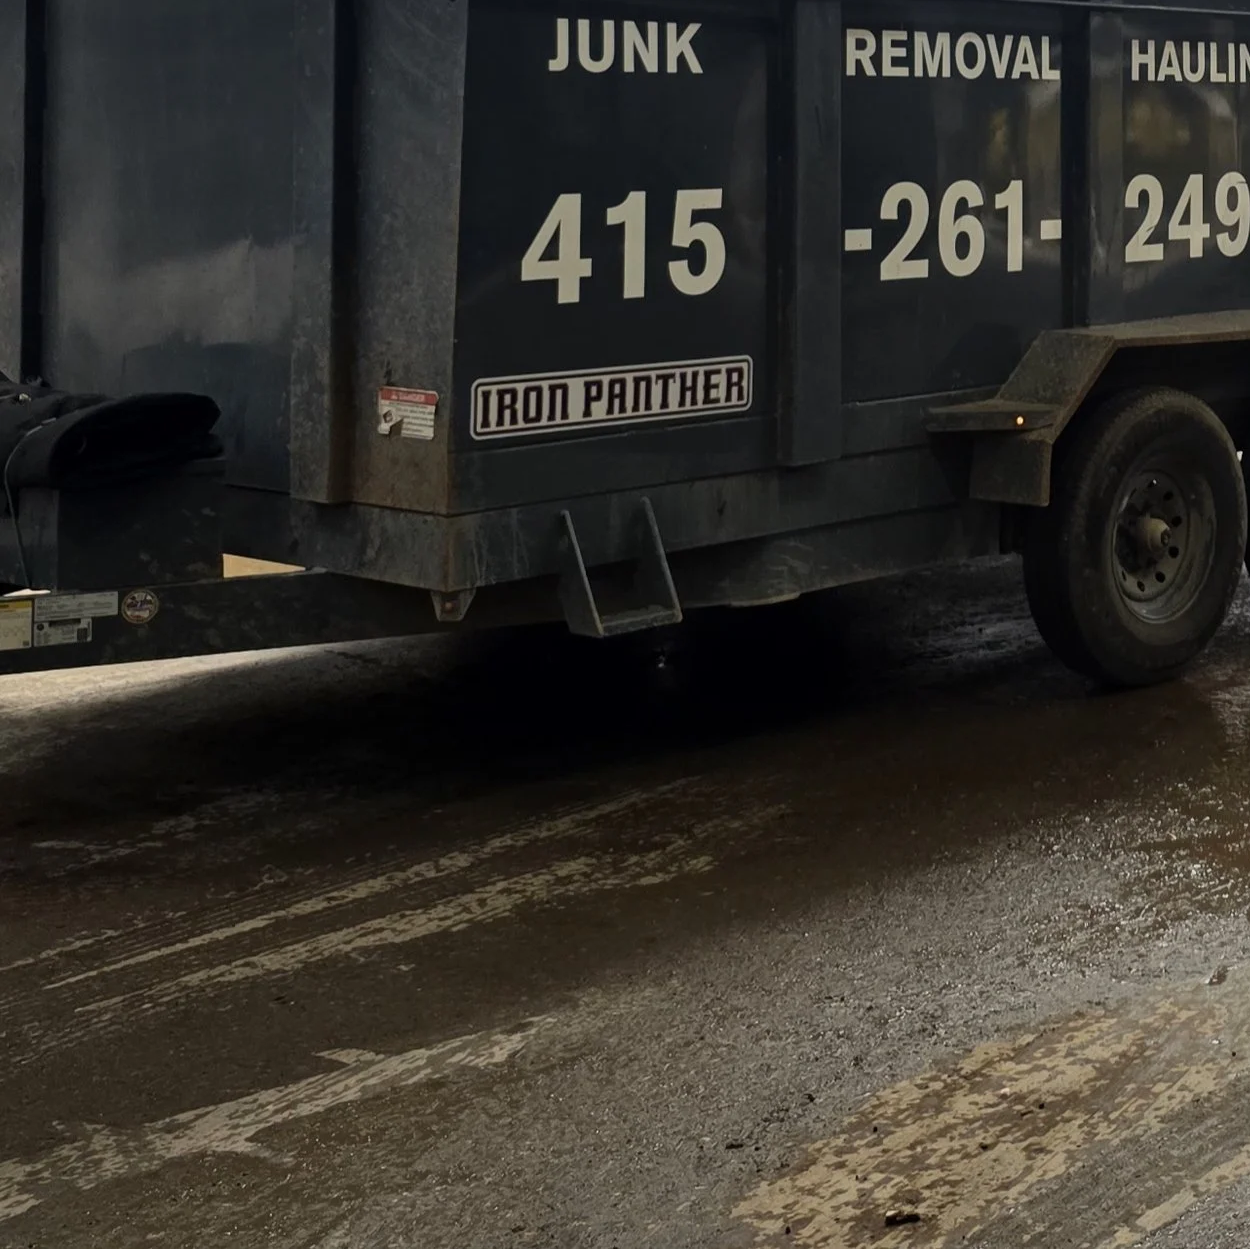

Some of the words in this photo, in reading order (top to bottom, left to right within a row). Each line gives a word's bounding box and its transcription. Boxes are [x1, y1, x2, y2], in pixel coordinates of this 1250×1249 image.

[548, 17, 703, 74] JUNK
[845, 27, 1061, 81] REMOVAL
[520, 187, 726, 304] 415
[480, 382, 570, 430] IRON
[582, 365, 746, 419] PANTHER
